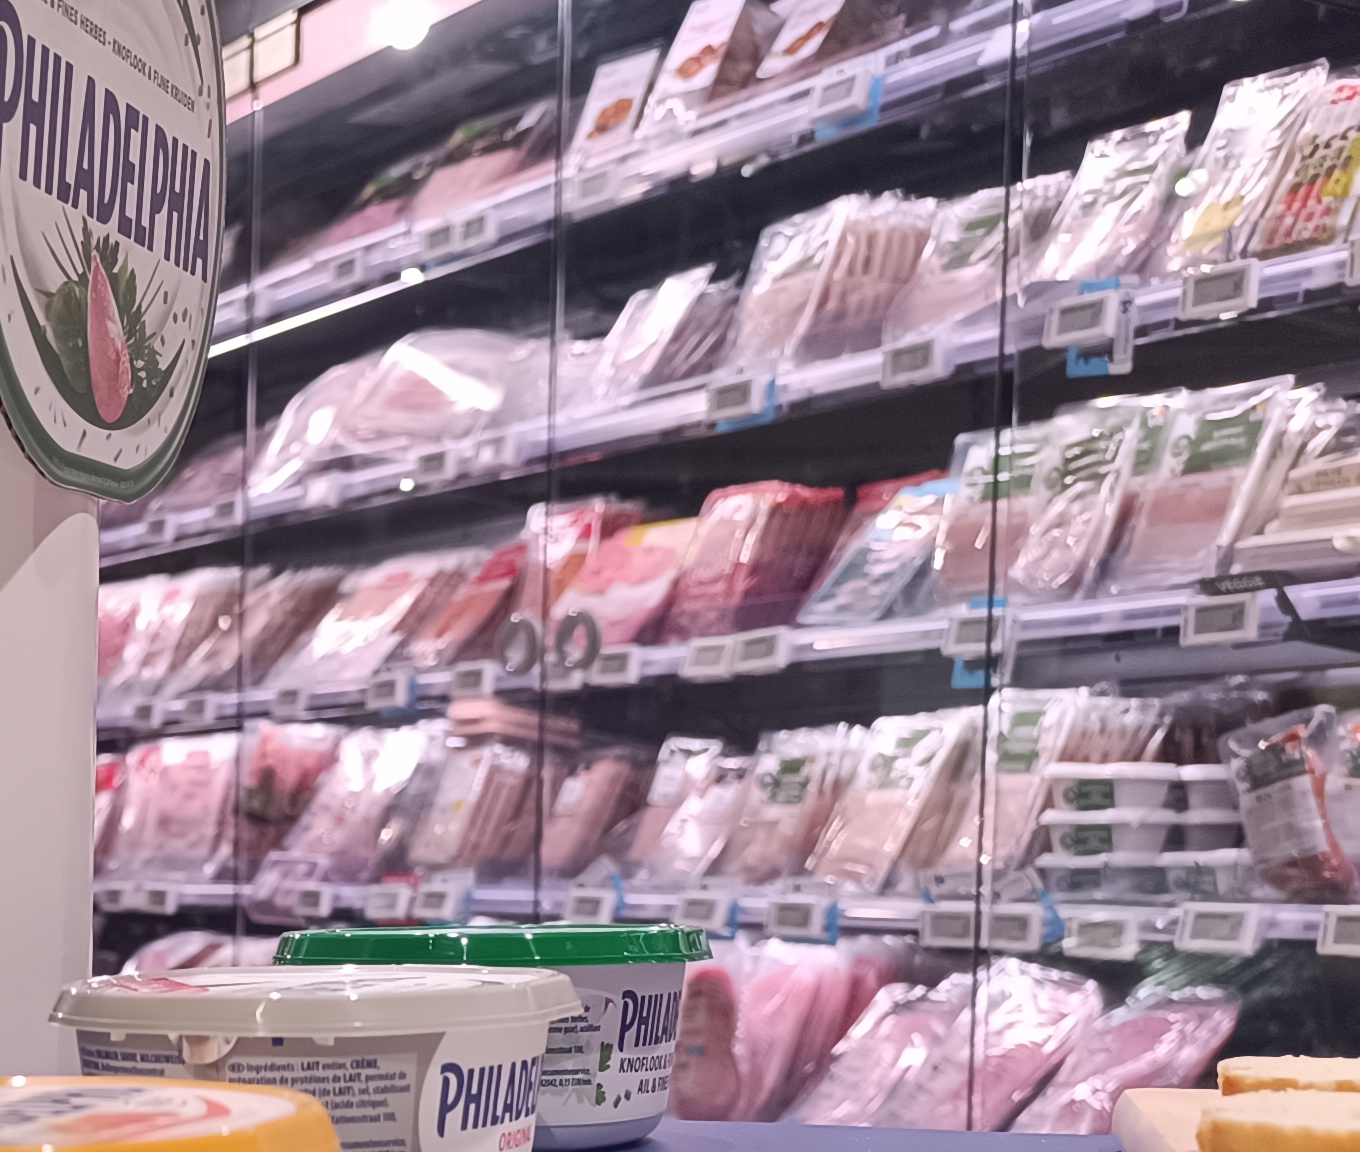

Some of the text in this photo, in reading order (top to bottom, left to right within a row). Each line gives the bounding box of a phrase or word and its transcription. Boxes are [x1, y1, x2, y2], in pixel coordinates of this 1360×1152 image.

[56, 0, 78, 26] FINES
[80, 13, 106, 47] HERBES
[112, 38, 147, 78] KNOFLOOK
[152, 68, 170, 95] FIJNE
[618, 989, 682, 1053] PHILAD
[618, 1054, 662, 1074] KNOFLOOK
